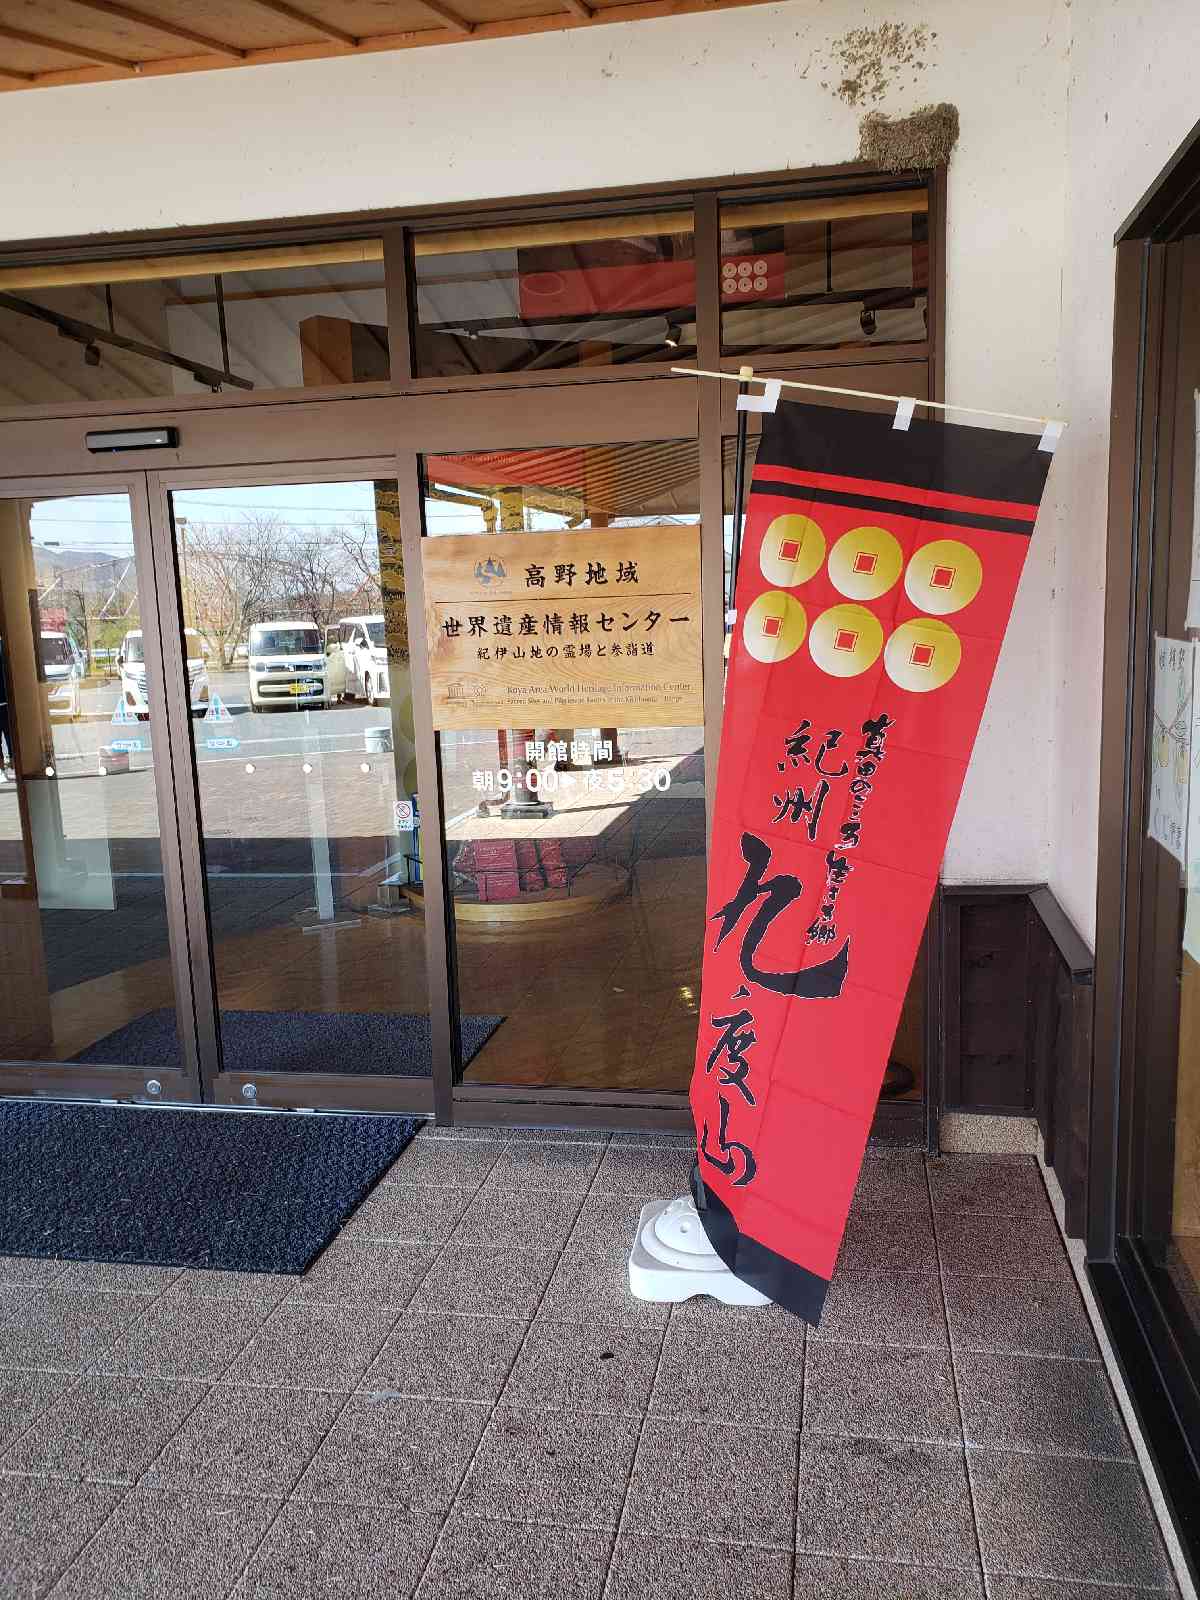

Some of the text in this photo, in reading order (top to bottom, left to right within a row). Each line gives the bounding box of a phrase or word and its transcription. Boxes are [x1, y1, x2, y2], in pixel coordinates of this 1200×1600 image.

[524, 560, 640, 588] 高野地域
[441, 610, 690, 639] 世界遺産情報センター
[477, 640, 656, 661] 紀伊山地の霊場と参詣道
[550, 683, 575, 694] World
[524, 740, 613, 763] 開館時間
[771, 718, 849, 842] 紀州
[700, 831, 851, 1187] 九度山
